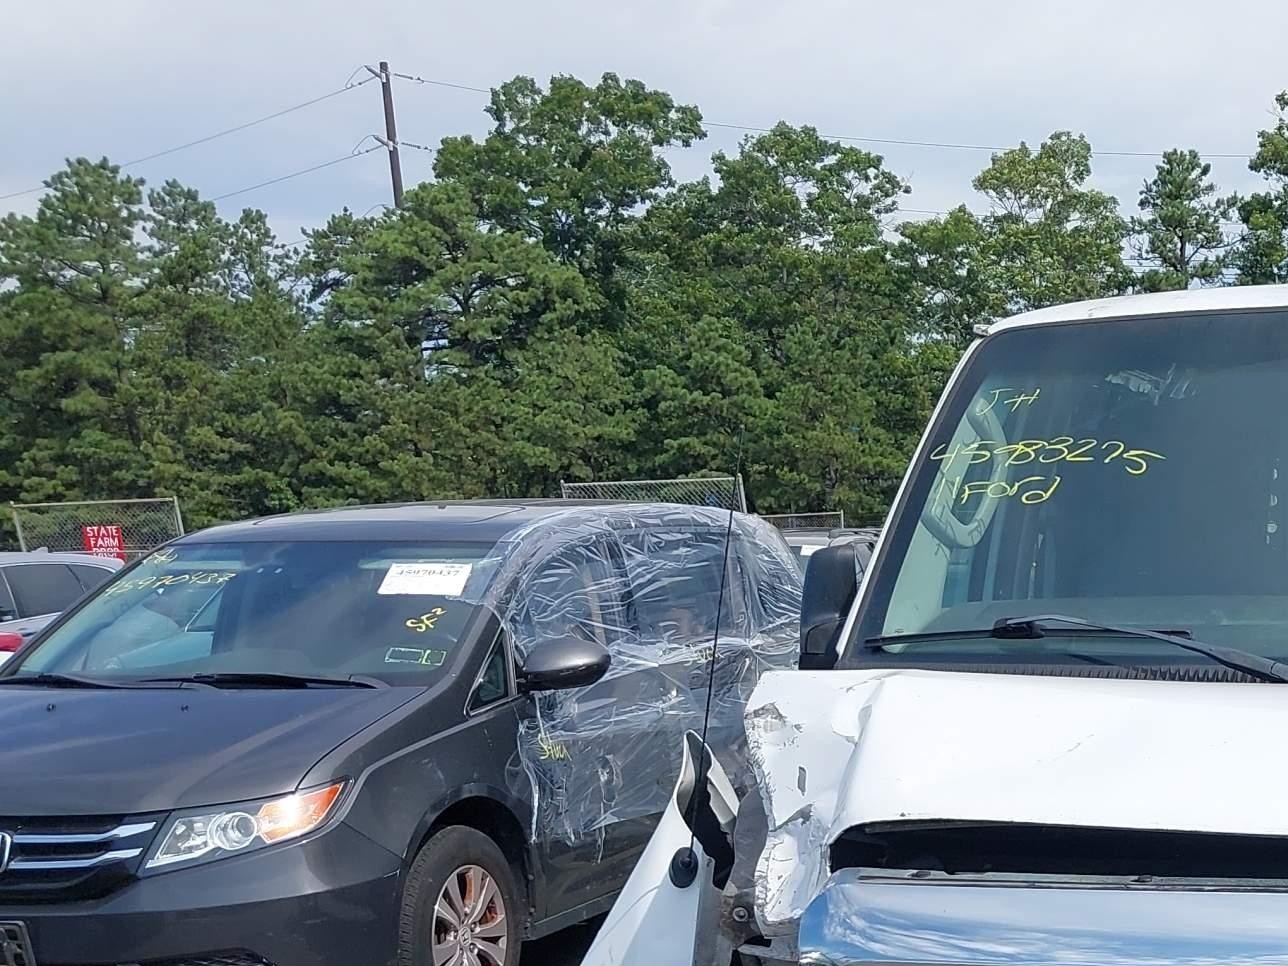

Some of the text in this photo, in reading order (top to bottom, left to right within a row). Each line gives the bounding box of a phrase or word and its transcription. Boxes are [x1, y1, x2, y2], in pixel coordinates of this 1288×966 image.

[930, 437, 1167, 475] 45983275
[86, 526, 119, 537] STATE
[90, 537, 119, 548] FARM
